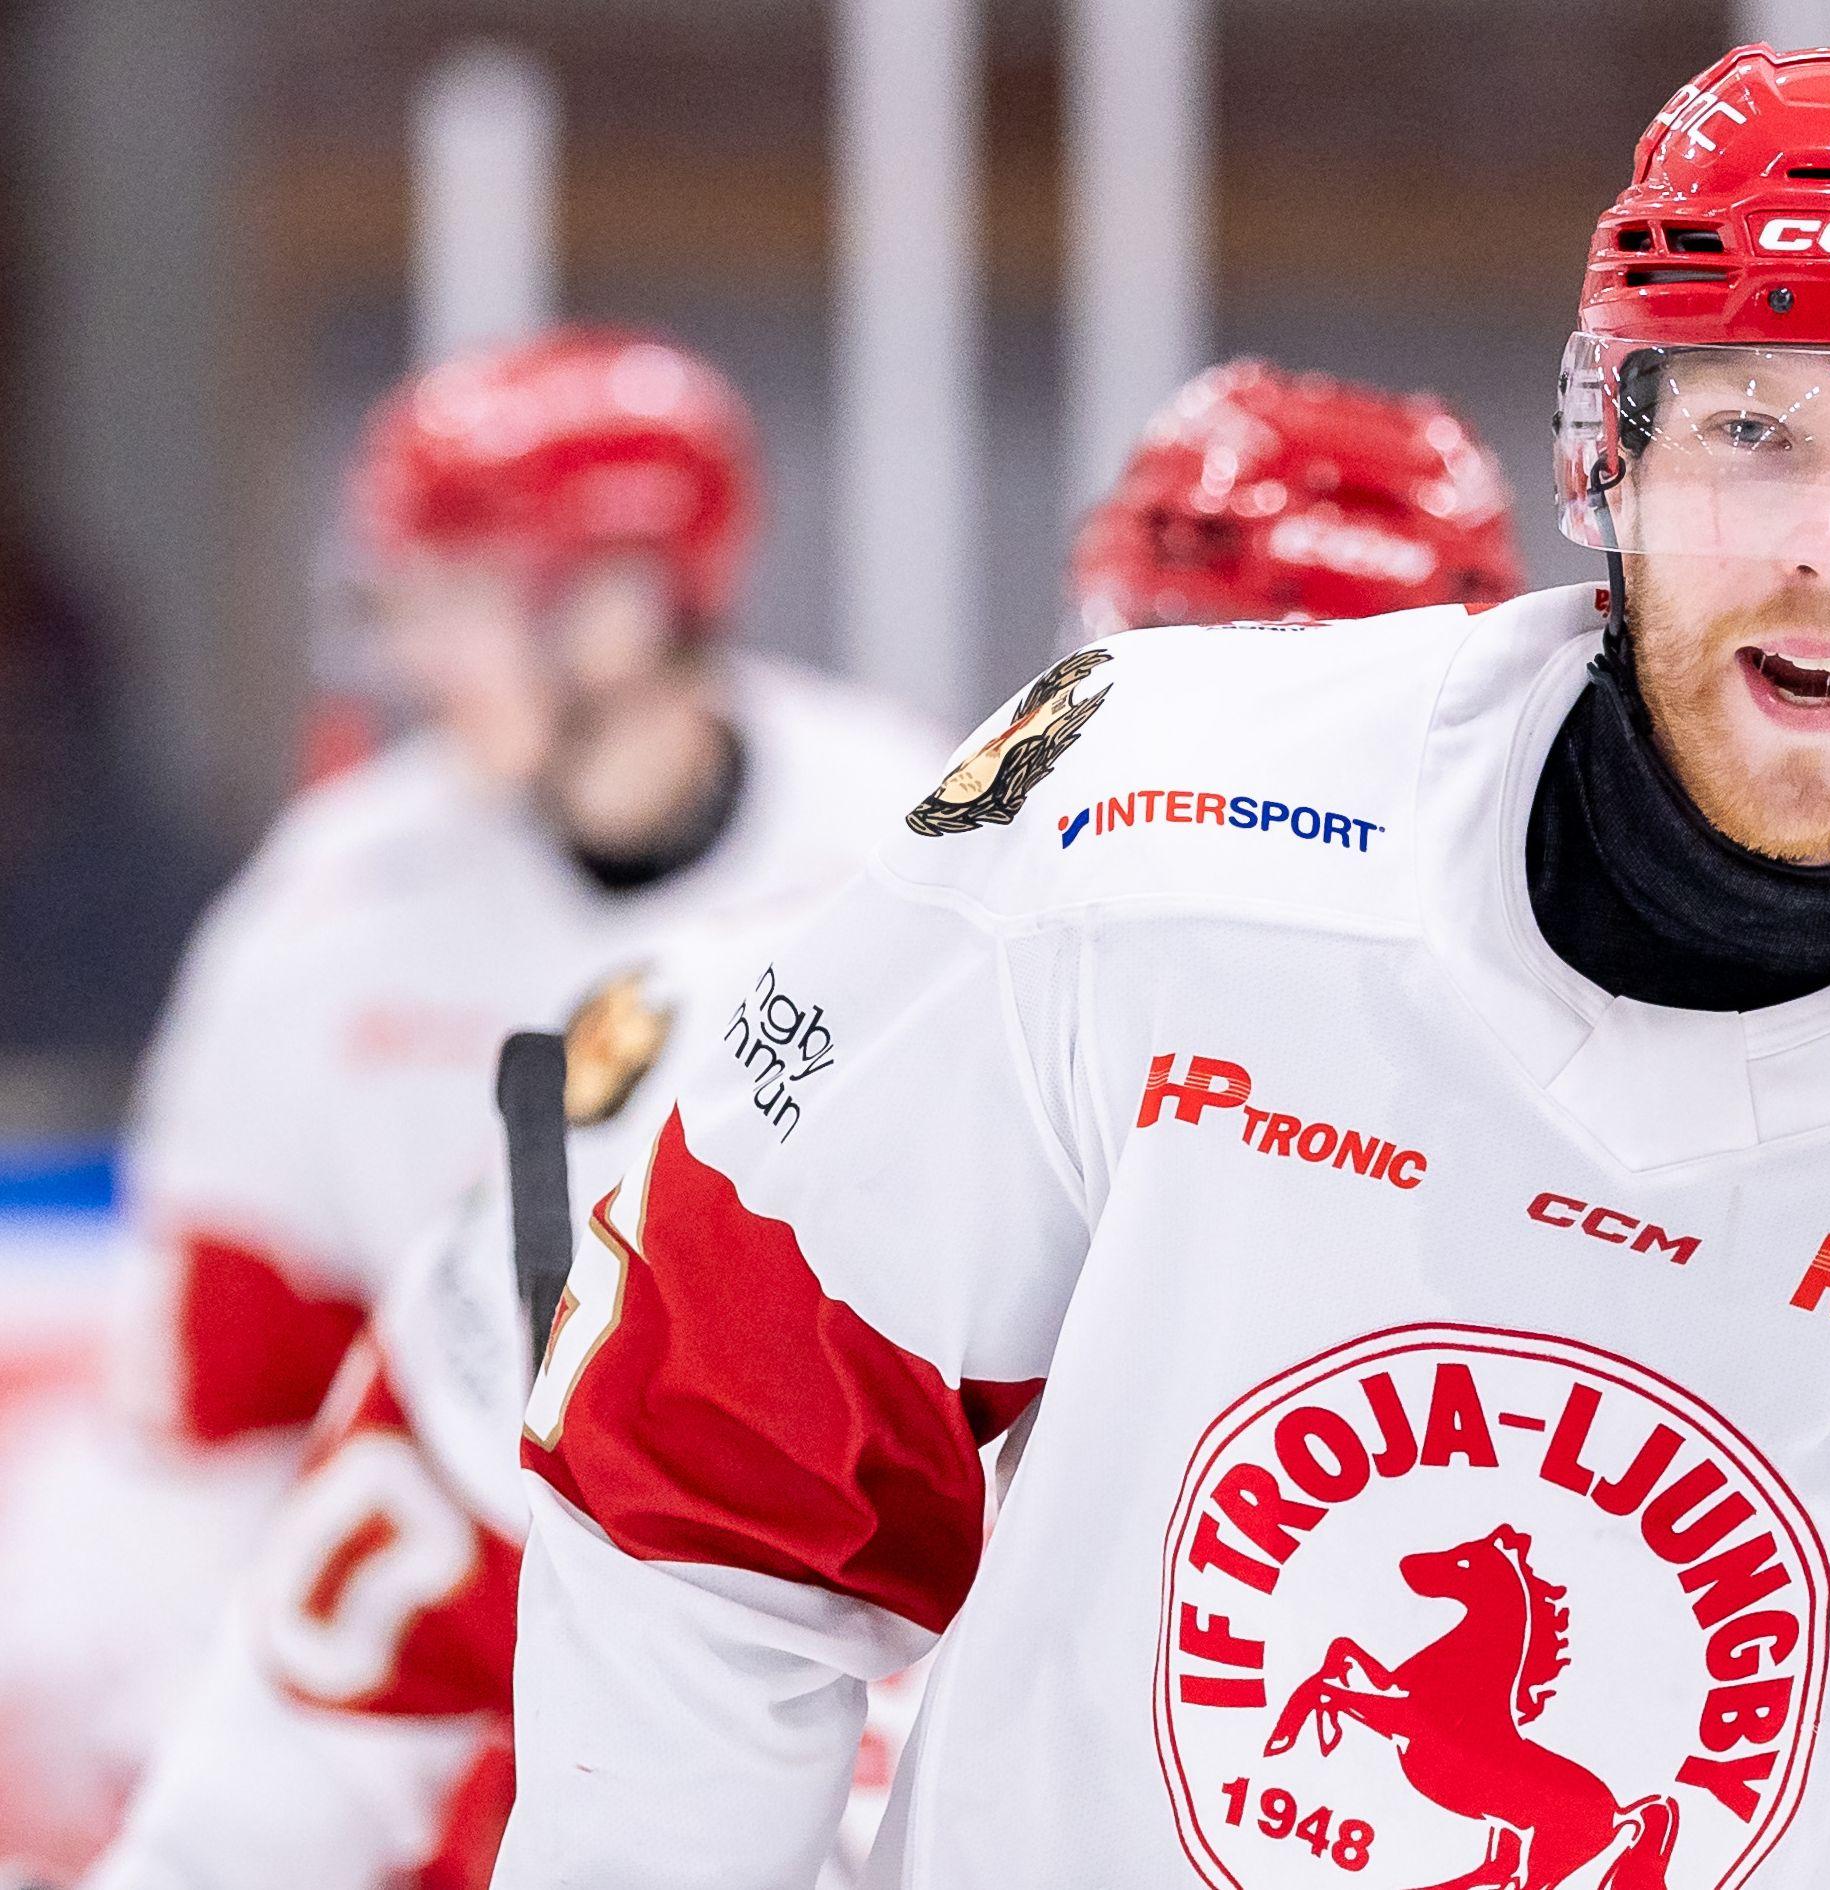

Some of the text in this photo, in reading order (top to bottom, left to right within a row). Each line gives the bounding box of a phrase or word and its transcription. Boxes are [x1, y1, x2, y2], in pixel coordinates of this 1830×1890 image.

[1095, 789, 1378, 852] INTERSPORT
[1527, 1192, 1701, 1265] CCM
[1178, 1362, 1800, 1824] IF TROJA-LJUNGBY
[1221, 1776, 1376, 1873] 1948
